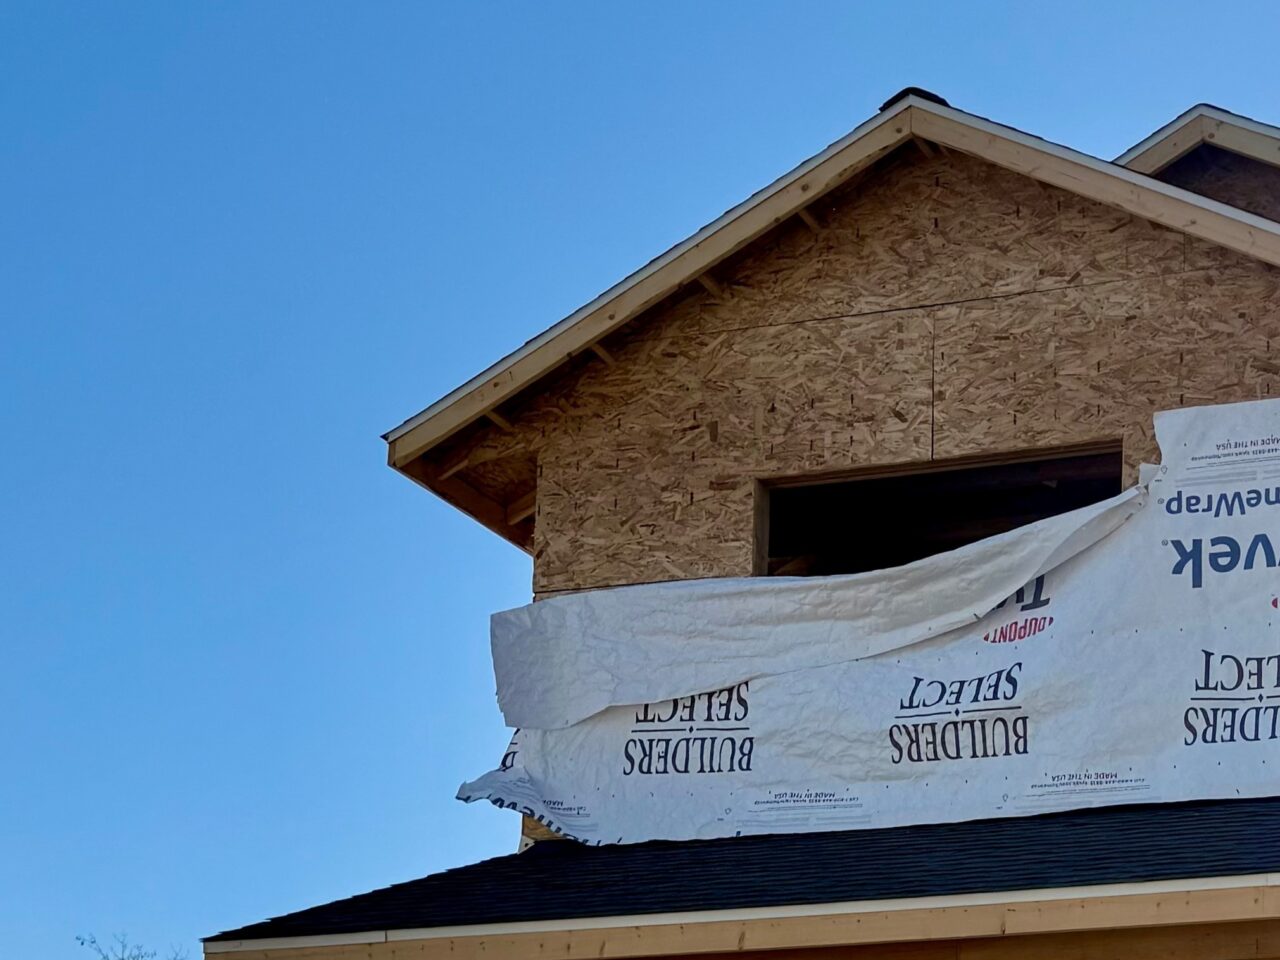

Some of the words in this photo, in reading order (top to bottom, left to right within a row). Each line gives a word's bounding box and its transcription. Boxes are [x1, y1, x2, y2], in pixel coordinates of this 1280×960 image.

[1215, 441, 1232, 450] USA
[1233, 440, 1249, 448] THE
[990, 616, 1047, 644] DUPONT
[636, 681, 749, 723] SELECT
[900, 662, 1023, 710] SELECT
[623, 736, 755, 776] BUILDERS
[888, 716, 1029, 764] BUILDERS
